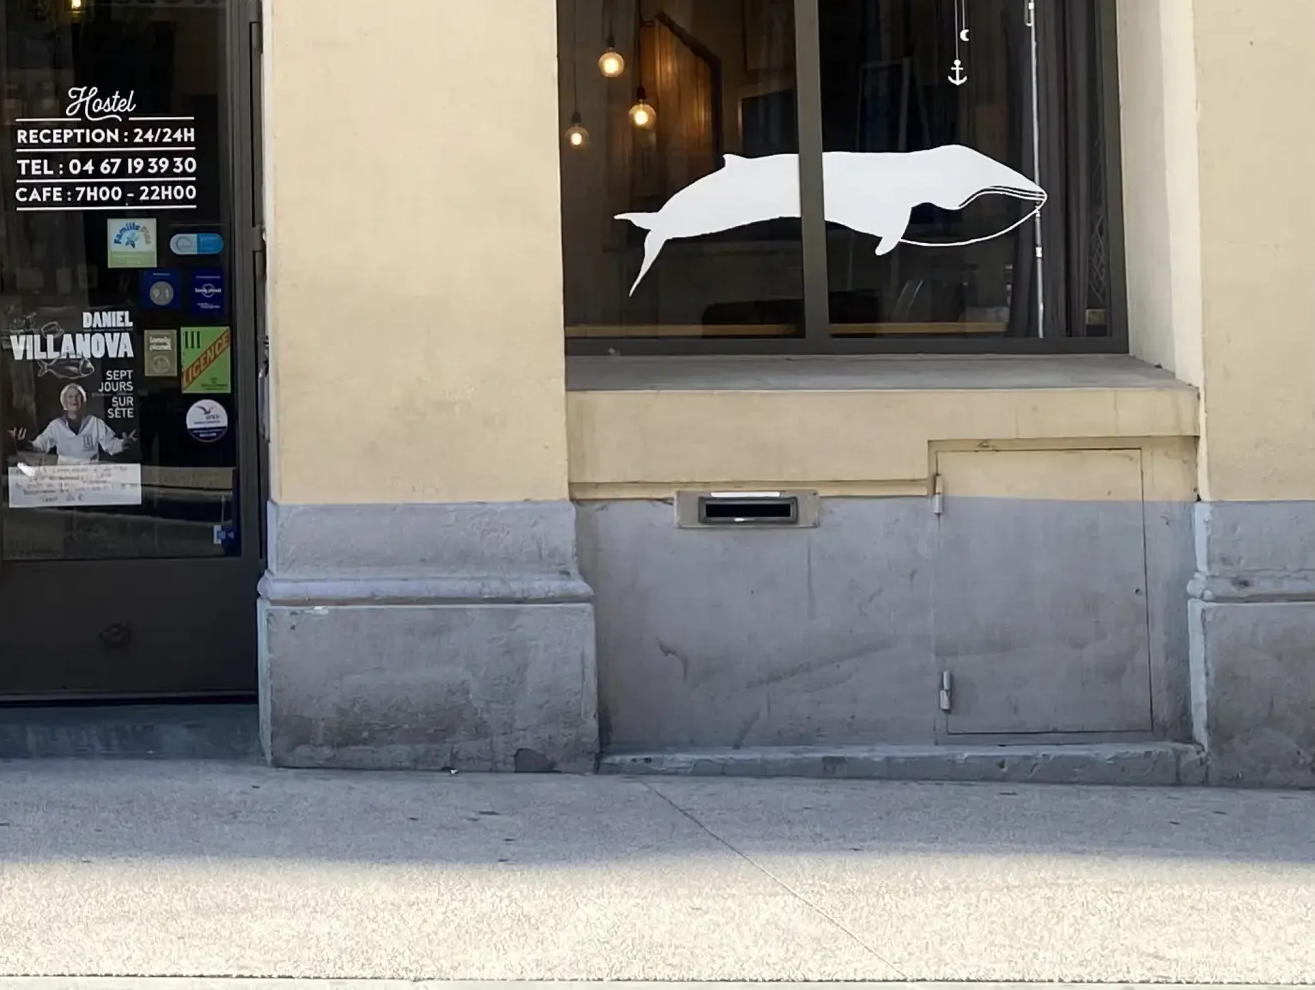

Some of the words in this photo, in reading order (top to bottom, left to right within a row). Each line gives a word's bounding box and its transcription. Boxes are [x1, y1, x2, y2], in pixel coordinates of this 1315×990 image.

[65, 86, 137, 122] Hostel
[17, 128, 119, 144] RECEPTION
[133, 127, 195, 143] 24/24H
[17, 159, 54, 175] TEL
[69, 158, 95, 175] 04
[100, 158, 122, 175] 67
[127, 157, 144, 174] 19
[147, 157, 170, 174] 39
[172, 157, 197, 173] 30
[15, 187, 63, 202] CAFE
[75, 186, 122, 202] 7H00
[139, 185, 197, 201] 22H00
[82, 311, 134, 328] DANIEL
[10, 332, 134, 360] VILLANOVA
[106, 369, 133, 381] SEPT
[98, 381, 134, 393] JOURS
[112, 396, 134, 407] SUR
